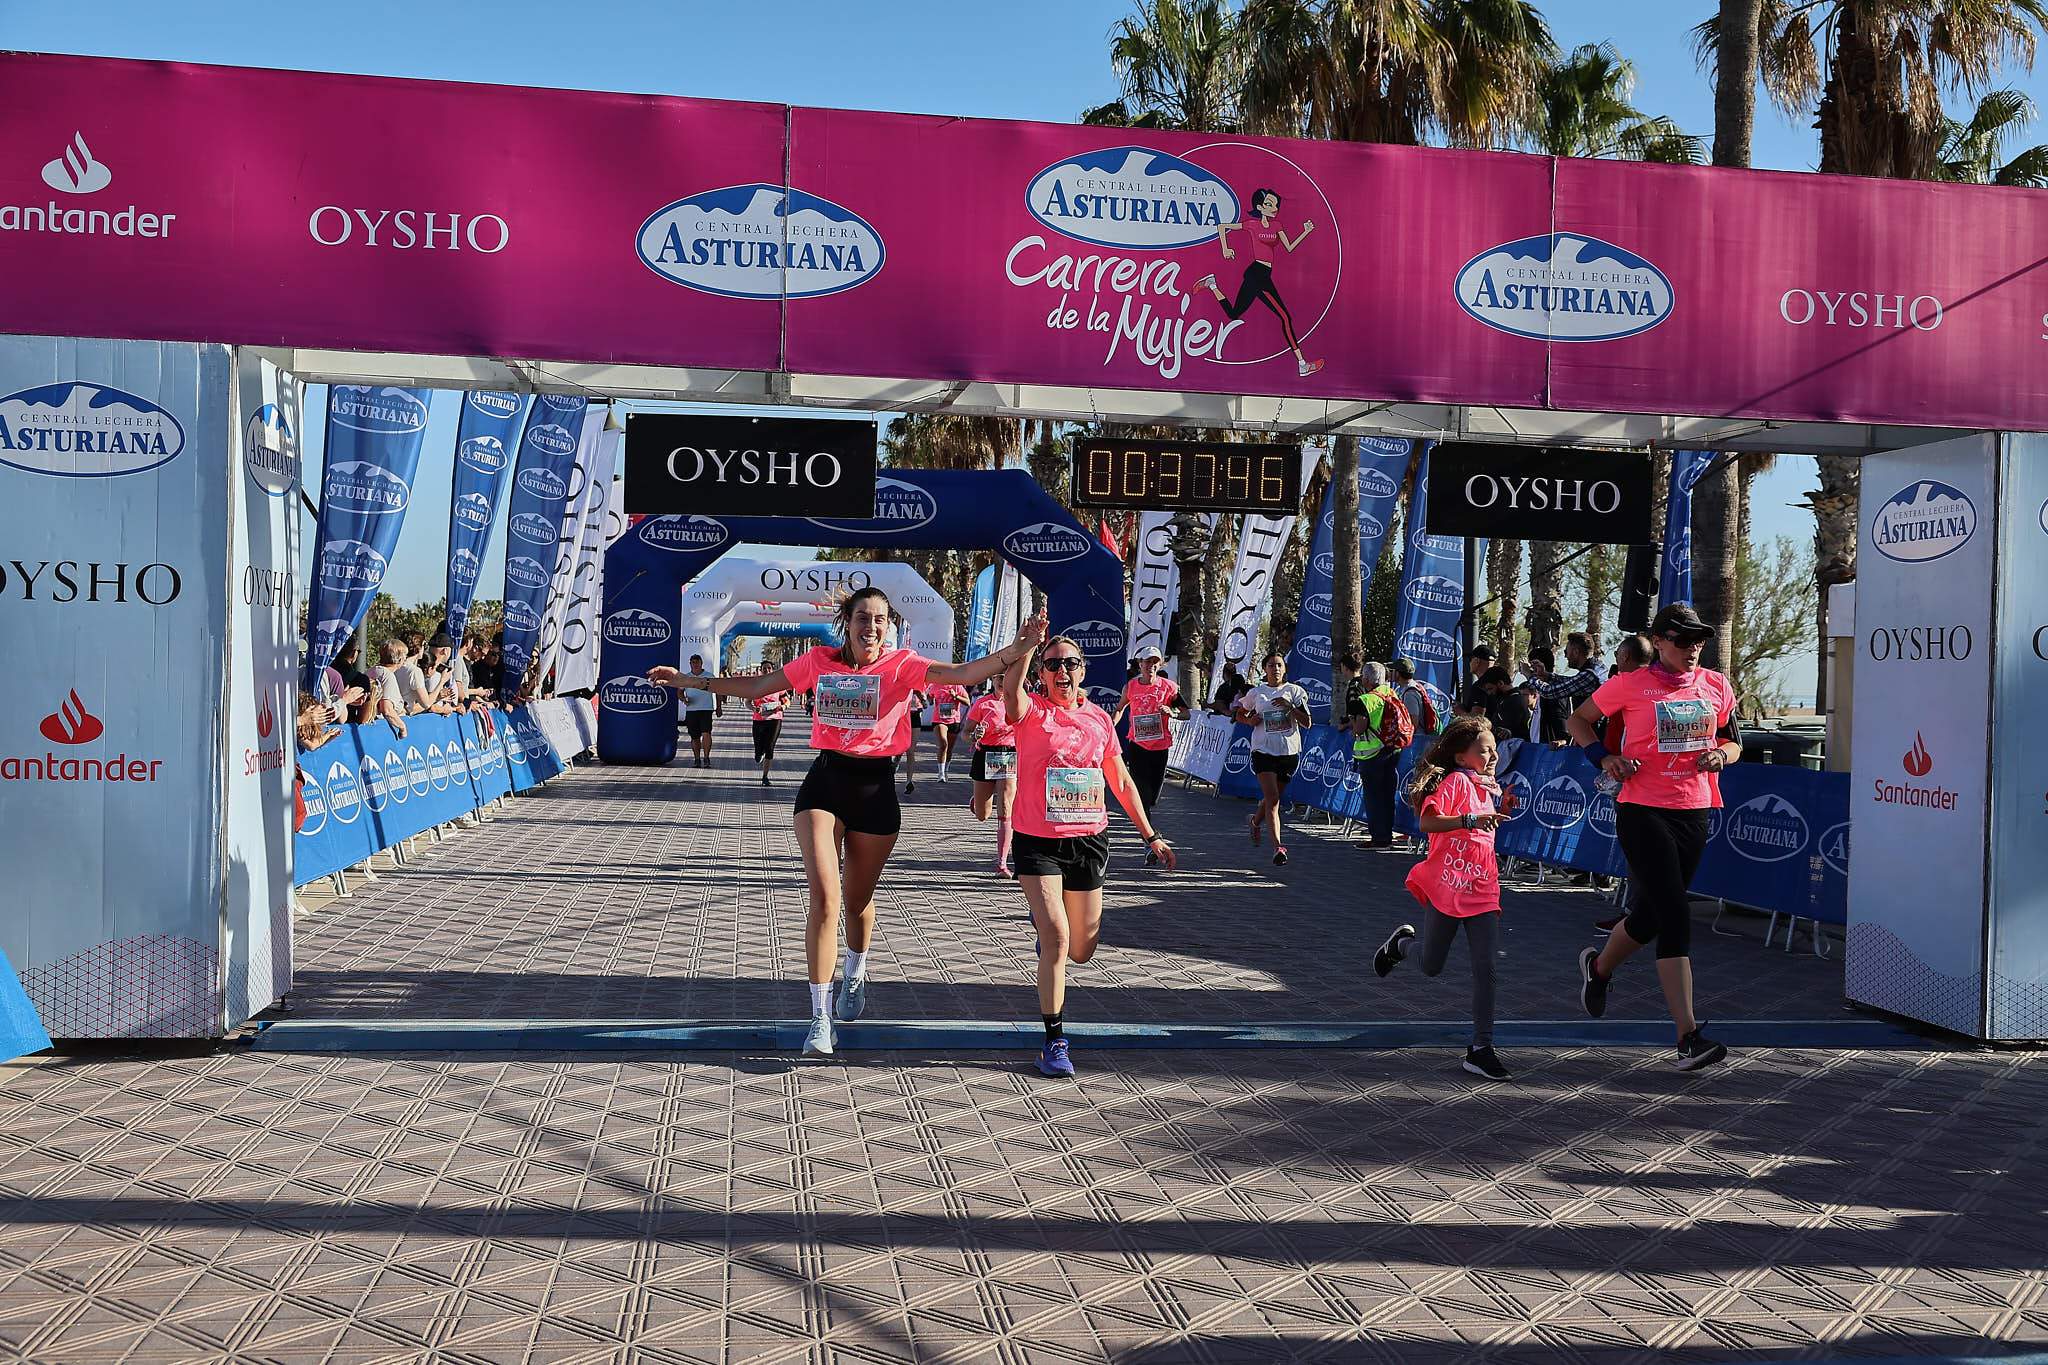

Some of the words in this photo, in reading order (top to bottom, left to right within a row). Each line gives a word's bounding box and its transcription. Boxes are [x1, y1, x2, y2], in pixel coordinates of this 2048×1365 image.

[1042, 178, 1222, 227] ASTURIANA
[1076, 179, 1144, 193] CENTRAL
[1150, 183, 1218, 198] LECHERA
[0, 200, 177, 238] antander
[309, 205, 509, 253] OYSHO
[695, 221, 772, 236] CENTRAL
[781, 224, 859, 239] LECHERA
[655, 222, 866, 273] ASTURIANA
[1005, 236, 1183, 297] Carrera
[1506, 268, 1574, 281] CENTRAL
[1582, 271, 1651, 284] LECHERA
[1472, 268, 1657, 316] ASTURIANA
[1780, 289, 1943, 331] OYSHO
[1047, 294, 1080, 330] de
[1087, 294, 1110, 332] la
[1103, 293, 1245, 379] Mujer
[20, 414, 87, 425] CENTRAL
[95, 416, 162, 427] LECHERA
[667, 446, 841, 487] OYSHO
[1089, 450, 1283, 501] 00:37:46
[521, 474, 562, 496] ASTURIANA
[877, 493, 922, 501] LECHERA
[1465, 474, 1621, 513] OYSHO
[1893, 508, 1926, 520] CENTRAL
[1929, 503, 1965, 516] LECHERA
[644, 525, 721, 542] ASTURIANA
[1878, 514, 1968, 545] ASTURIANA
[1010, 537, 1086, 554] ASTURIANA
[0, 560, 181, 605] YSHO
[244, 565, 293, 609] OYSHO
[761, 568, 871, 592] OYSHO
[1224, 514, 1281, 663] OYSH
[693, 591, 728, 600] OYSHO
[902, 595, 935, 604] OYSHO
[606, 621, 667, 638] ASTURIANA
[1870, 625, 1972, 662] OYSHO
[918, 641, 948, 650] OYSHO
[602, 687, 663, 705] ASTURIANA
[0, 753, 163, 781] antander
[1536, 793, 1581, 818] ASTURIANA
[1874, 779, 1959, 811] Santander
[1449, 837, 1468, 853] TU
[1731, 814, 1798, 849] ASTURIANA
